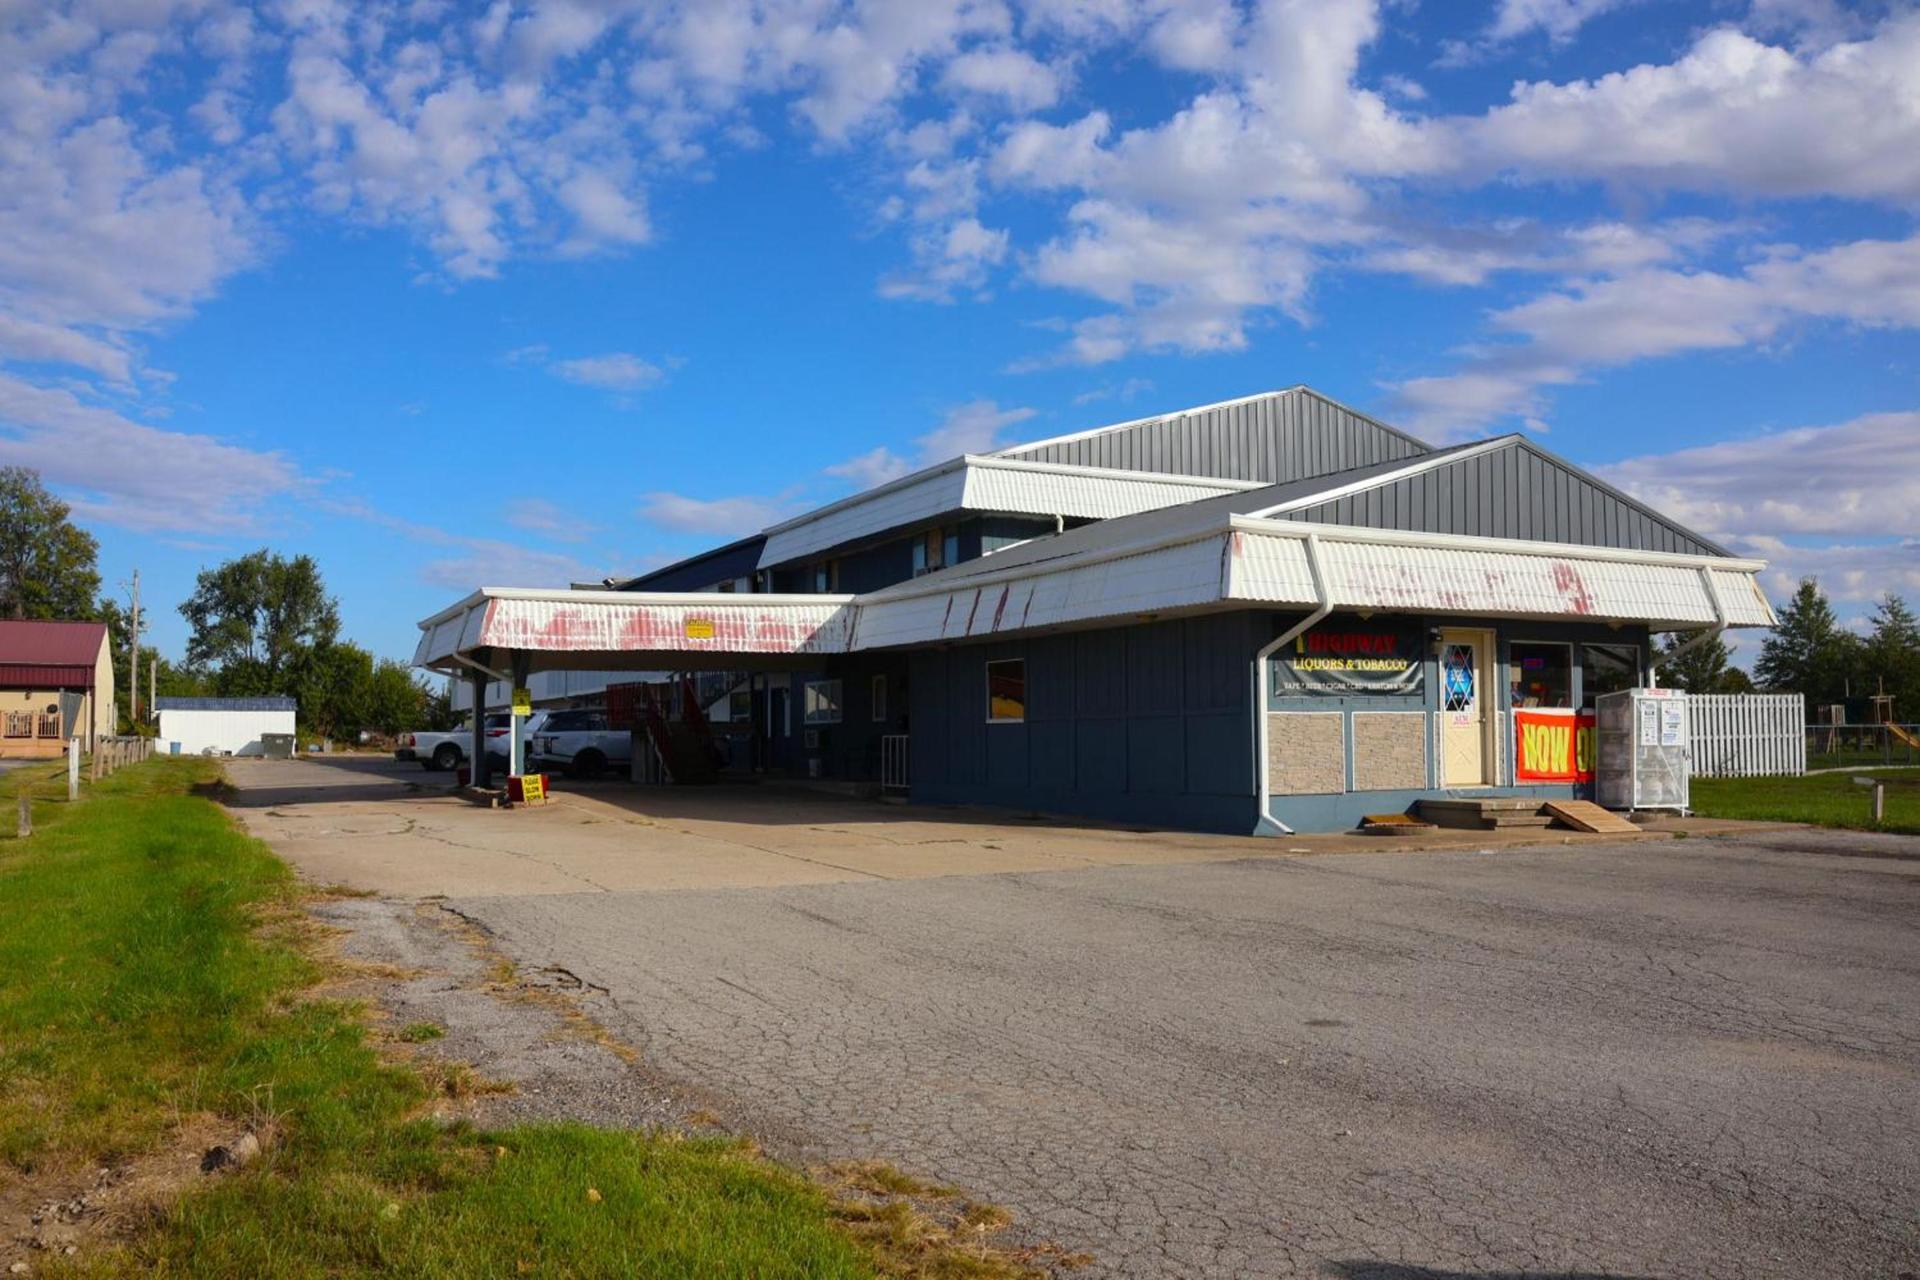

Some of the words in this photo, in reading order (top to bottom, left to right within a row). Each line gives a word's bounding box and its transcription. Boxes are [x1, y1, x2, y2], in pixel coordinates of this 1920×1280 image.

[1308, 633, 1397, 655] HIGHWAY
[1294, 657, 1344, 671] LIQUORS
[1346, 658, 1355, 671] &
[1358, 659, 1407, 671] TOBACCO
[1522, 723, 1570, 773] NOW
